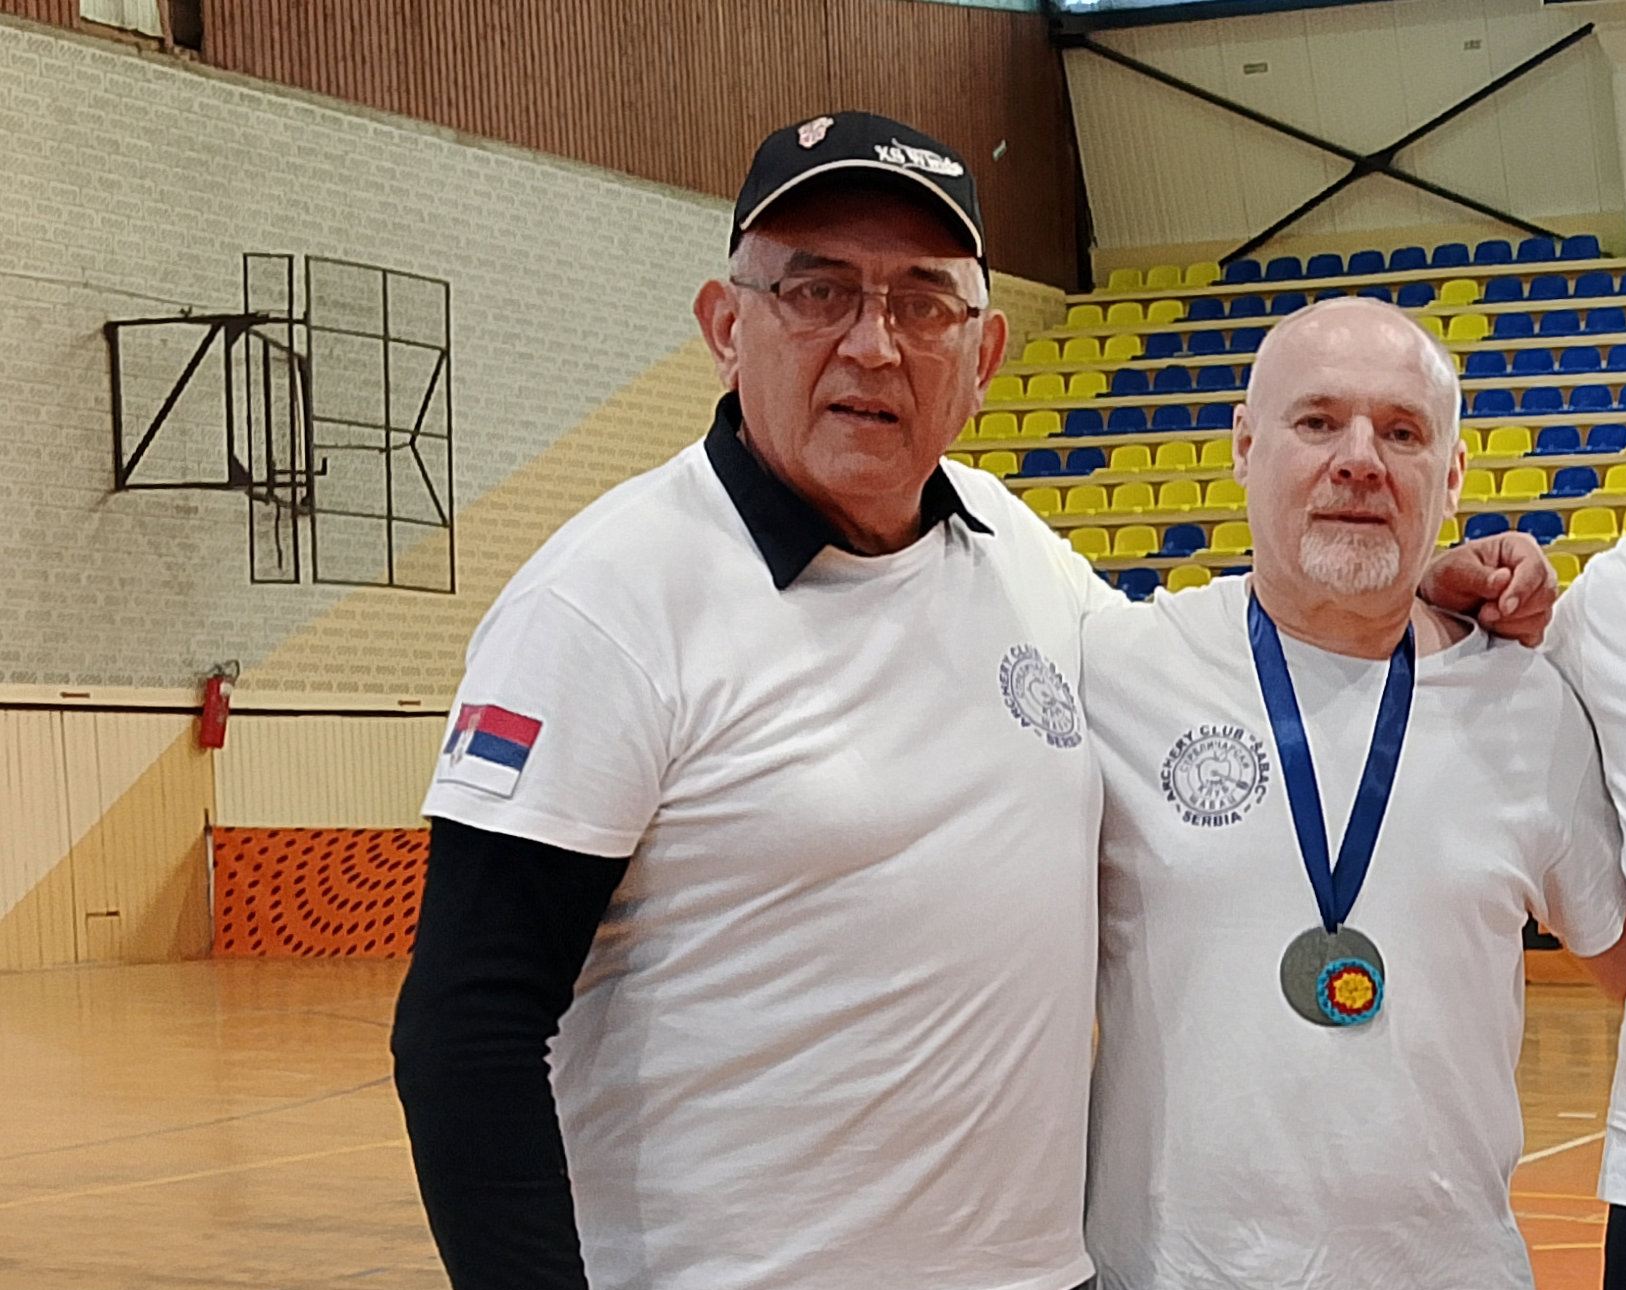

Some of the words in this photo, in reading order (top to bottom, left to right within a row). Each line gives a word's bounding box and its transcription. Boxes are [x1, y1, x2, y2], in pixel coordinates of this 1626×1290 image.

[1161, 730, 1194, 801] ARCHERY
[1199, 724, 1245, 740] CLUB
[1182, 811, 1243, 828] SERBIA
